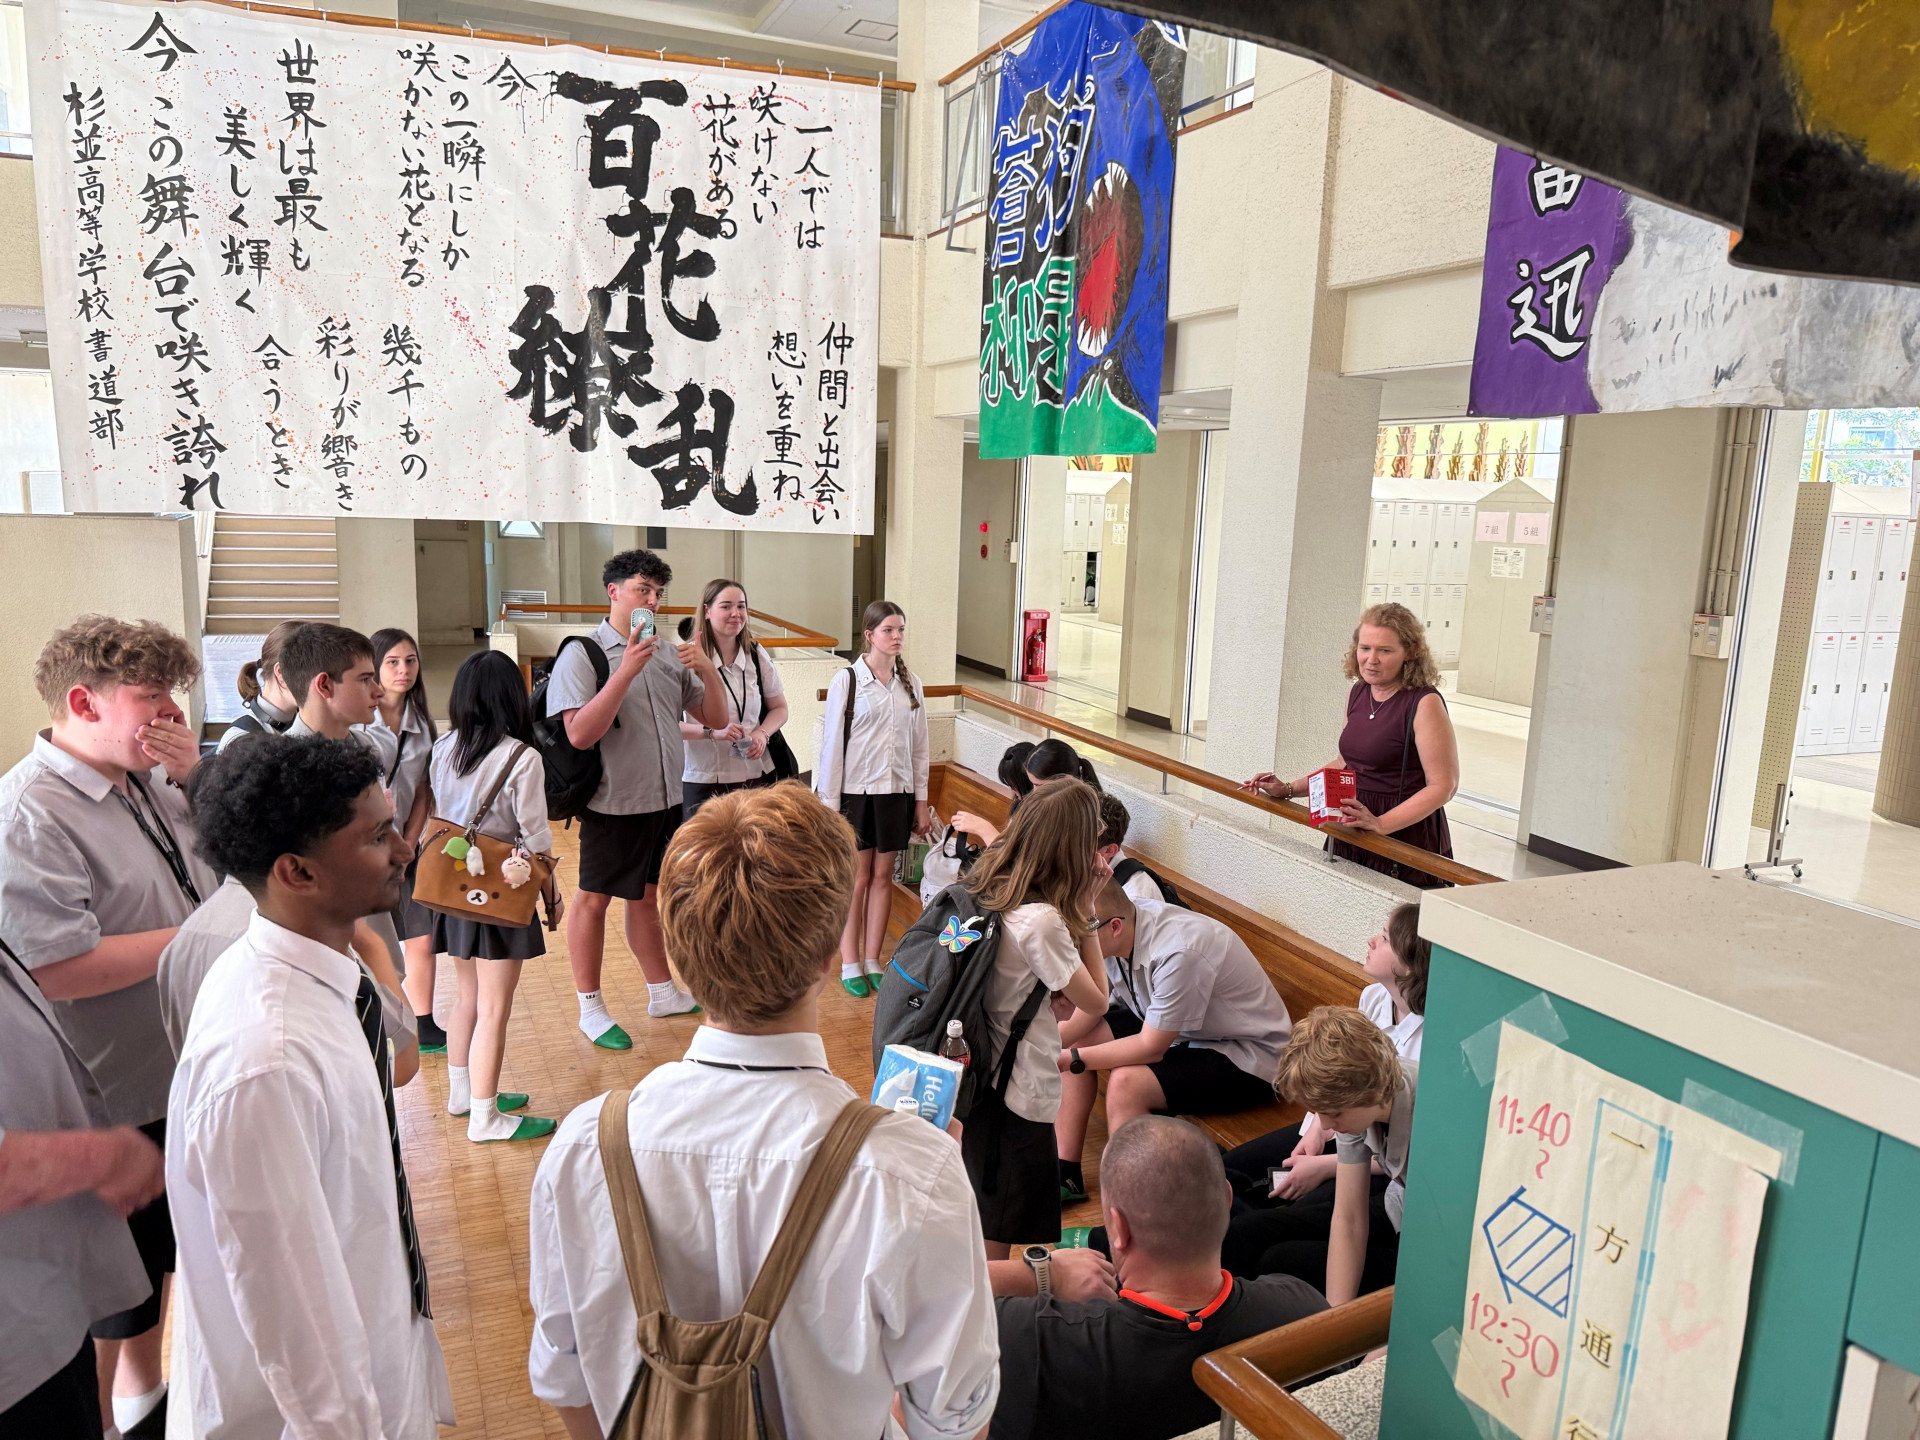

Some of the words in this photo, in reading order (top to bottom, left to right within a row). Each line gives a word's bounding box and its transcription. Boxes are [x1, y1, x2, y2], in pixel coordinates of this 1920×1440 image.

[215, 105, 271, 314] 美しく輝く
[273, 37, 329, 273] 世界は最も
[397, 41, 447, 288] 咲かない花となる
[441, 53, 487, 271] この一瞬にしか
[700, 93, 739, 239] 花がある
[749, 81, 786, 224] 咲けない
[794, 125, 833, 250] 一人では
[251, 333, 296, 489] 合うとき
[313, 316, 362, 511] 彩りが響き
[381, 323, 428, 481] 幾千もの
[764, 330, 806, 502] 想いを重ね
[809, 321, 855, 526] 仲間と出会い
[1498, 1094, 1572, 1148] 11:40
[1471, 1292, 1560, 1378] 12:30
